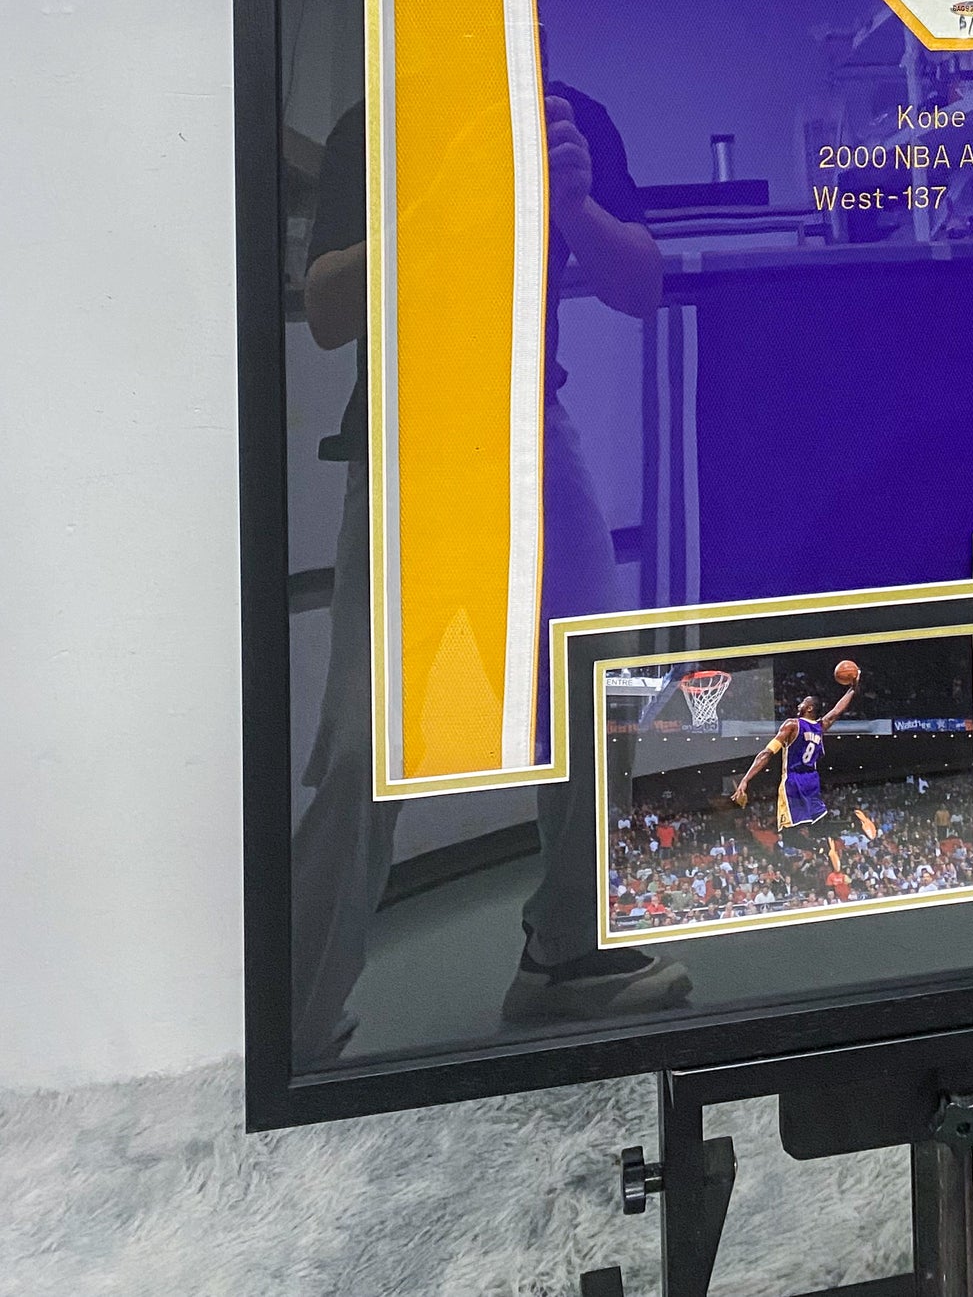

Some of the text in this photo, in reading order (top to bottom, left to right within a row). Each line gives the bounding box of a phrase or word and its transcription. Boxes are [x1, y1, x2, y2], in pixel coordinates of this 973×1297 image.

[897, 105, 966, 130] Kobe
[819, 145, 888, 169] 2000
[894, 144, 951, 170] NBA
[813, 186, 947, 211] West-137
[802, 741, 816, 764] 8
